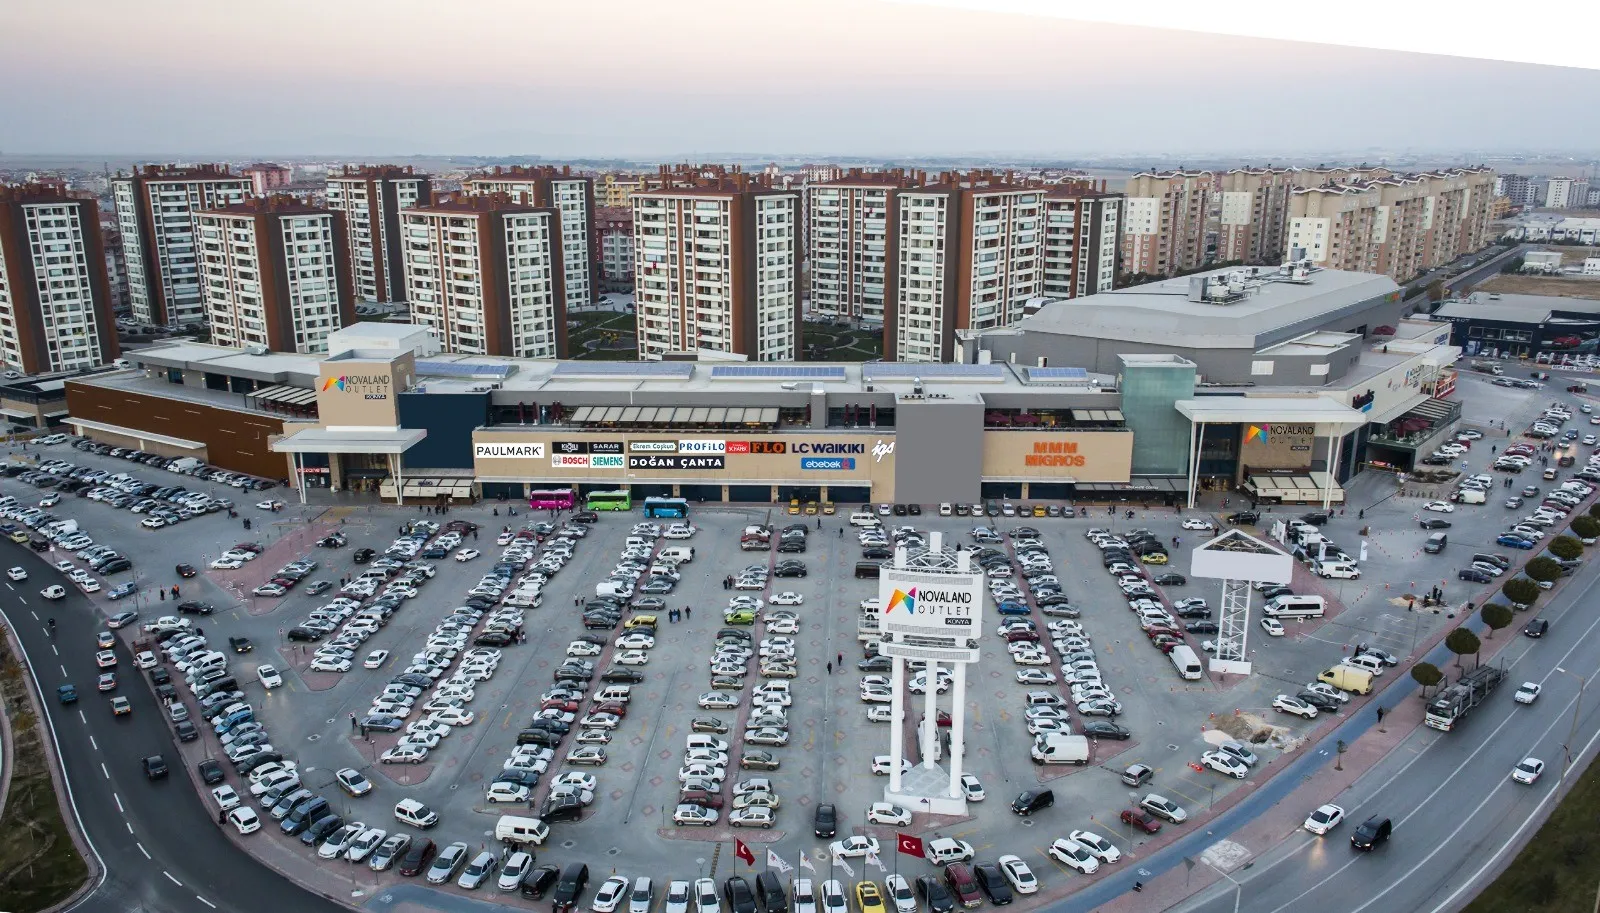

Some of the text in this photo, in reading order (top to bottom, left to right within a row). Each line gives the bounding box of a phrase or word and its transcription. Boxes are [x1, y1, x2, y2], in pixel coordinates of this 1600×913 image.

[345, 375, 390, 385] NOVALAND
[345, 385, 389, 394] OUTLET
[1270, 425, 1314, 435] NOVALAND
[476, 446, 540, 456] PAULMARK
[751, 442, 785, 453] FLO
[791, 443, 809, 454] LC
[1033, 441, 1078, 454] MMM
[562, 455, 588, 465] BOSCH
[592, 456, 623, 466] SIEMENS
[630, 456, 722, 468] DOĞAN ÇANTA
[805, 460, 841, 469] ebebek
[1025, 454, 1086, 467] MIGROS
[918, 590, 972, 604] NOVALAND
[918, 605, 971, 616] OUTLET
